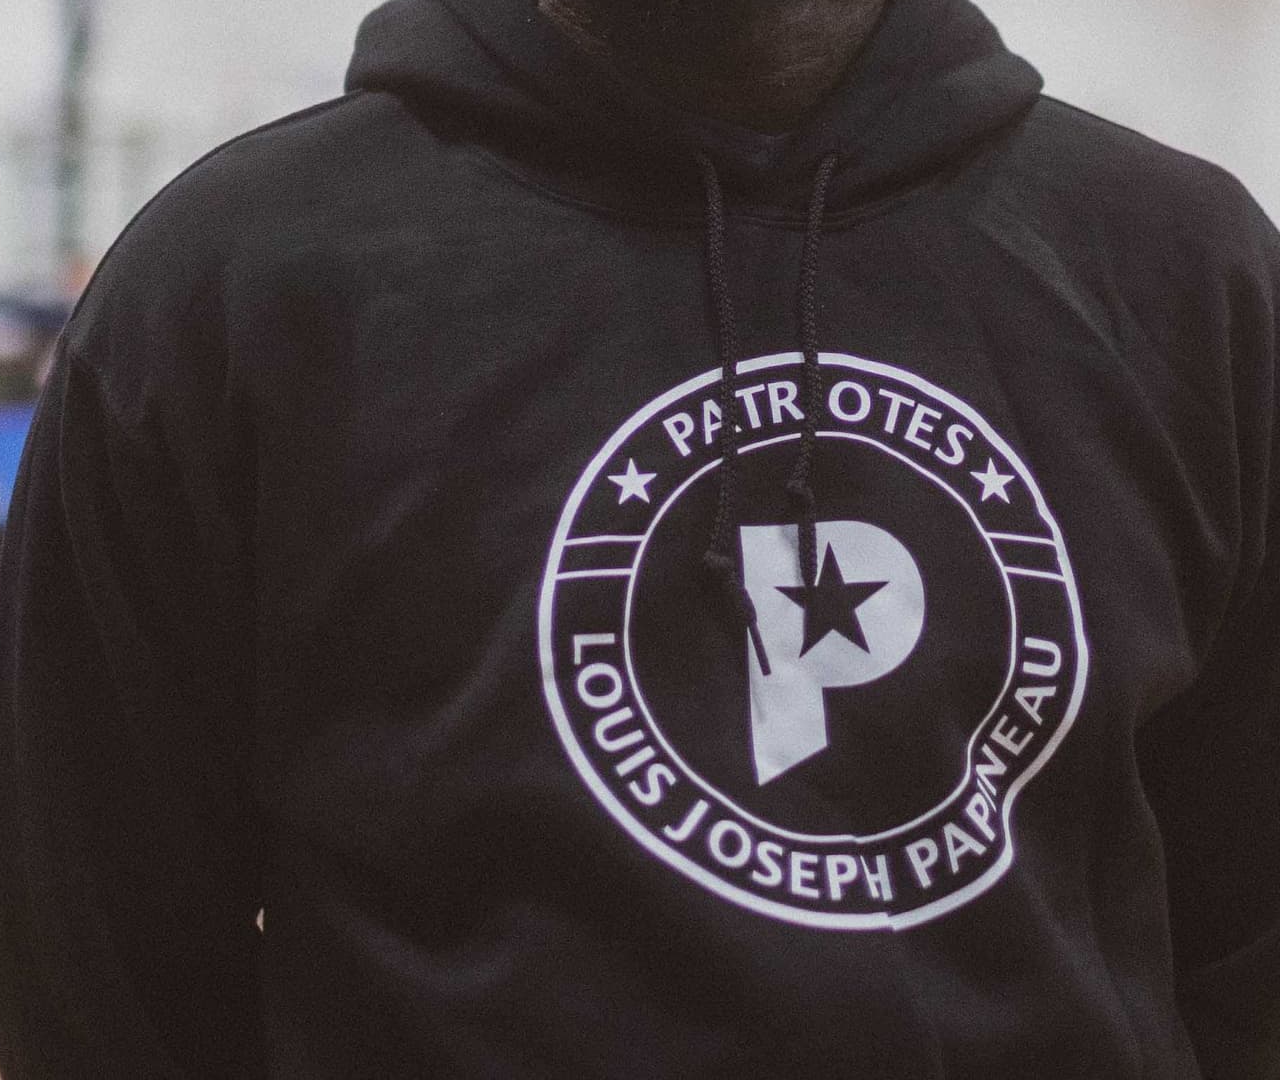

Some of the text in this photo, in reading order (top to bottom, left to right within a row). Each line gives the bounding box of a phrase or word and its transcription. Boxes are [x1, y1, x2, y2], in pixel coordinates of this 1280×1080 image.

[663, 380, 974, 466] PATROTES
[574, 633, 676, 806] LOUIS
[663, 799, 893, 902] JOSEPH
